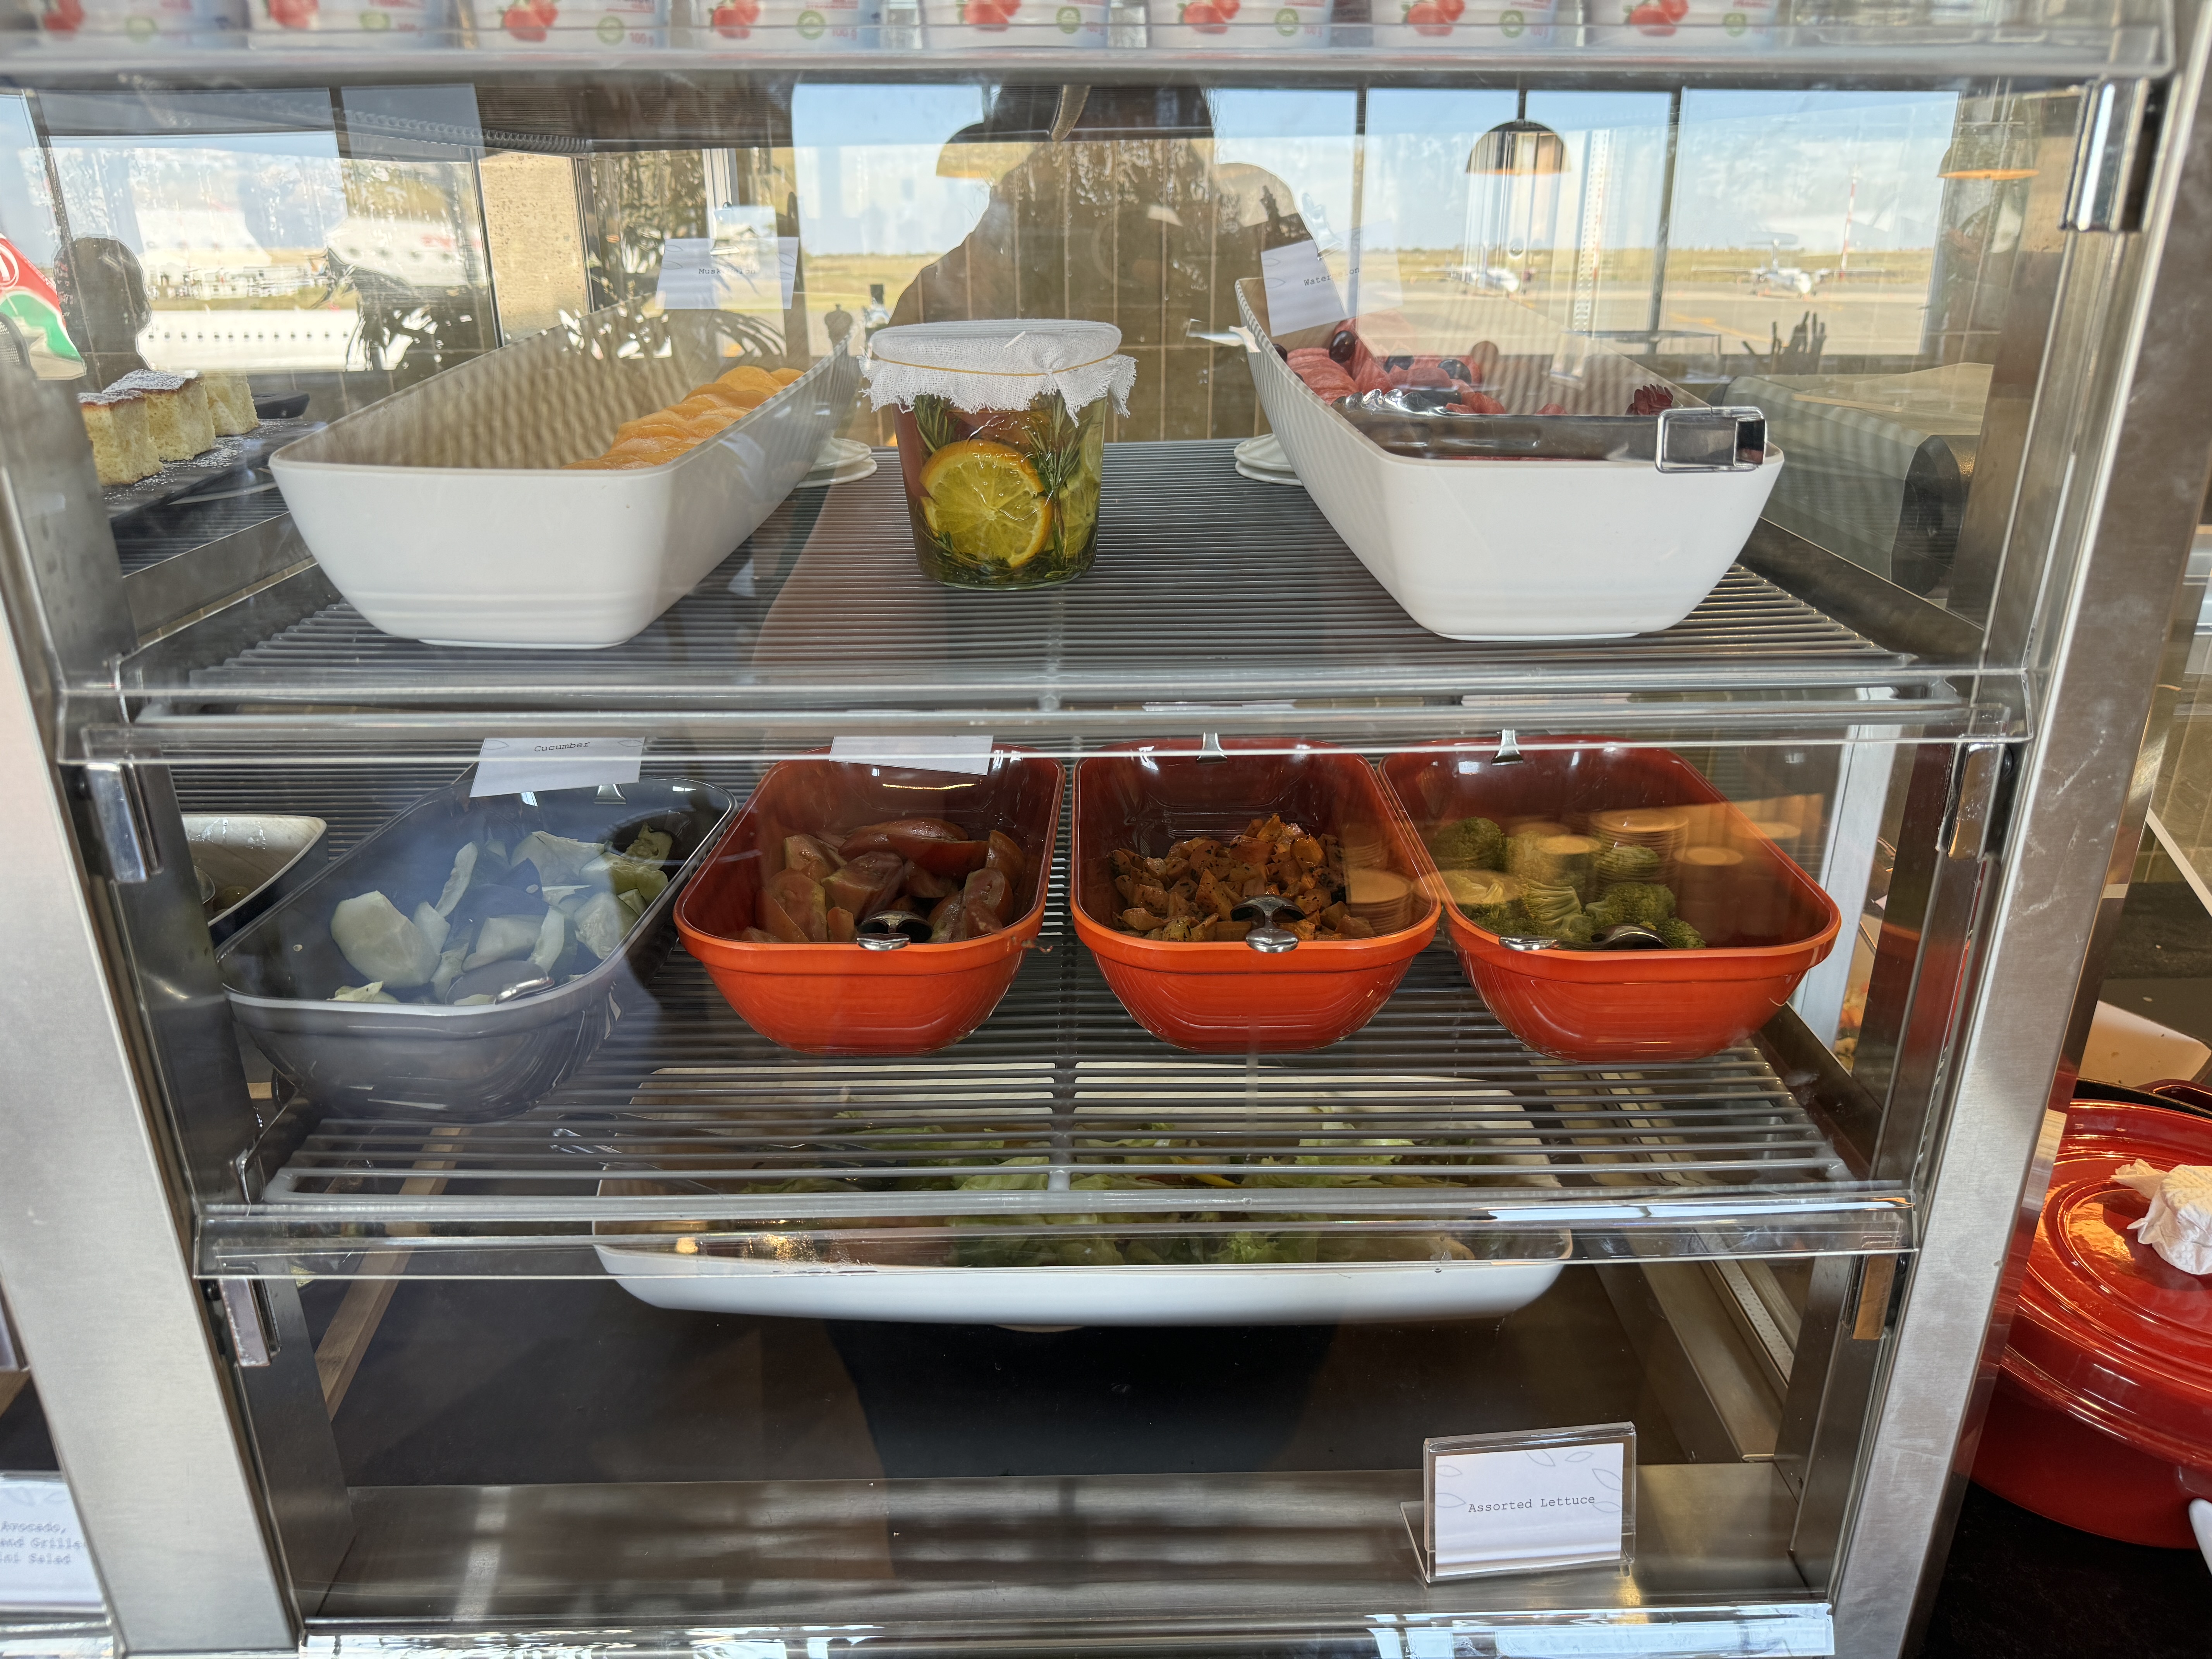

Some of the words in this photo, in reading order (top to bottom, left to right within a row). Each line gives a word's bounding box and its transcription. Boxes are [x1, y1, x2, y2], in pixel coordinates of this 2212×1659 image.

[1304, 268, 1360, 286] Waterelon
[534, 742, 591, 752] Cucumber
[1468, 1499, 1532, 1512] Assorted
[1540, 1496, 1595, 1507] Lettuce
[31, 1537, 84, 1549] Grille
